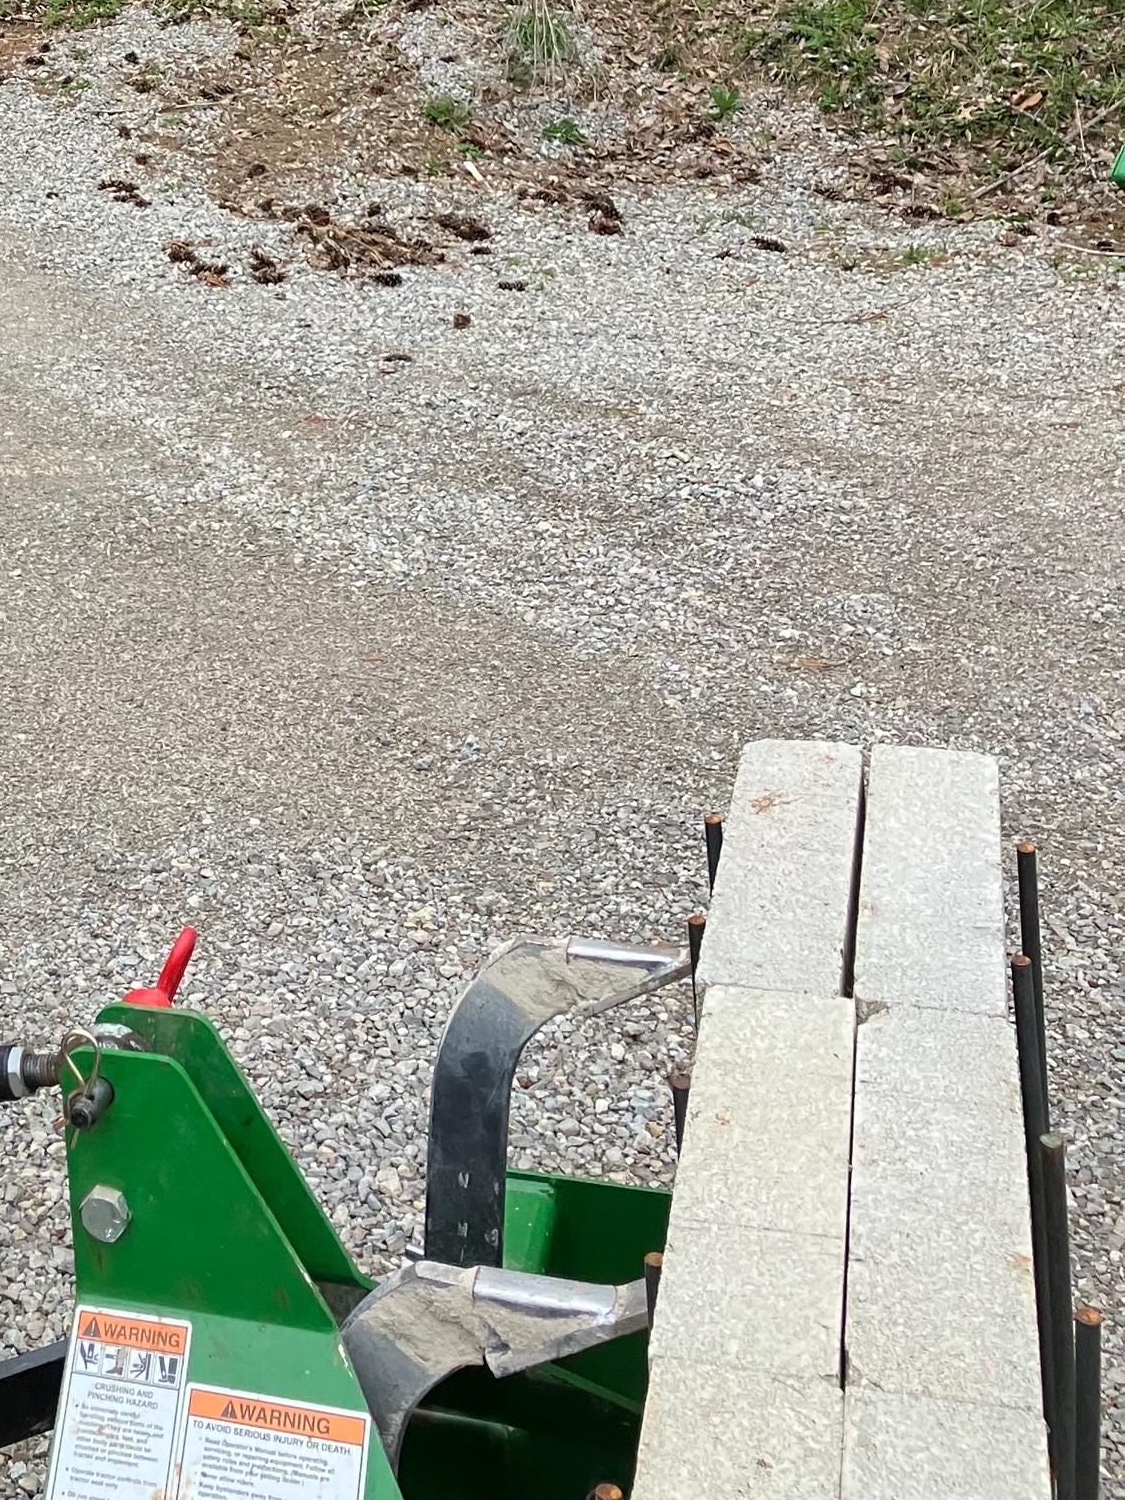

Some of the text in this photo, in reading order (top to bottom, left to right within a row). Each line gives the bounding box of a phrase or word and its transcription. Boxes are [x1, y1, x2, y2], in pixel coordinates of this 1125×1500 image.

[103, 1322, 180, 1348] WARNING
[87, 1392, 158, 1410] PINCHING HAZARD
[94, 1382, 154, 1398] CRUSHING AND
[239, 1403, 331, 1435] WARNING
[193, 1420, 204, 1429] TO
[205, 1422, 231, 1434] AVOID
[233, 1428, 271, 1442] SERIOUS
[273, 1434, 304, 1447] INJURY
[306, 1440, 319, 1450] OR
